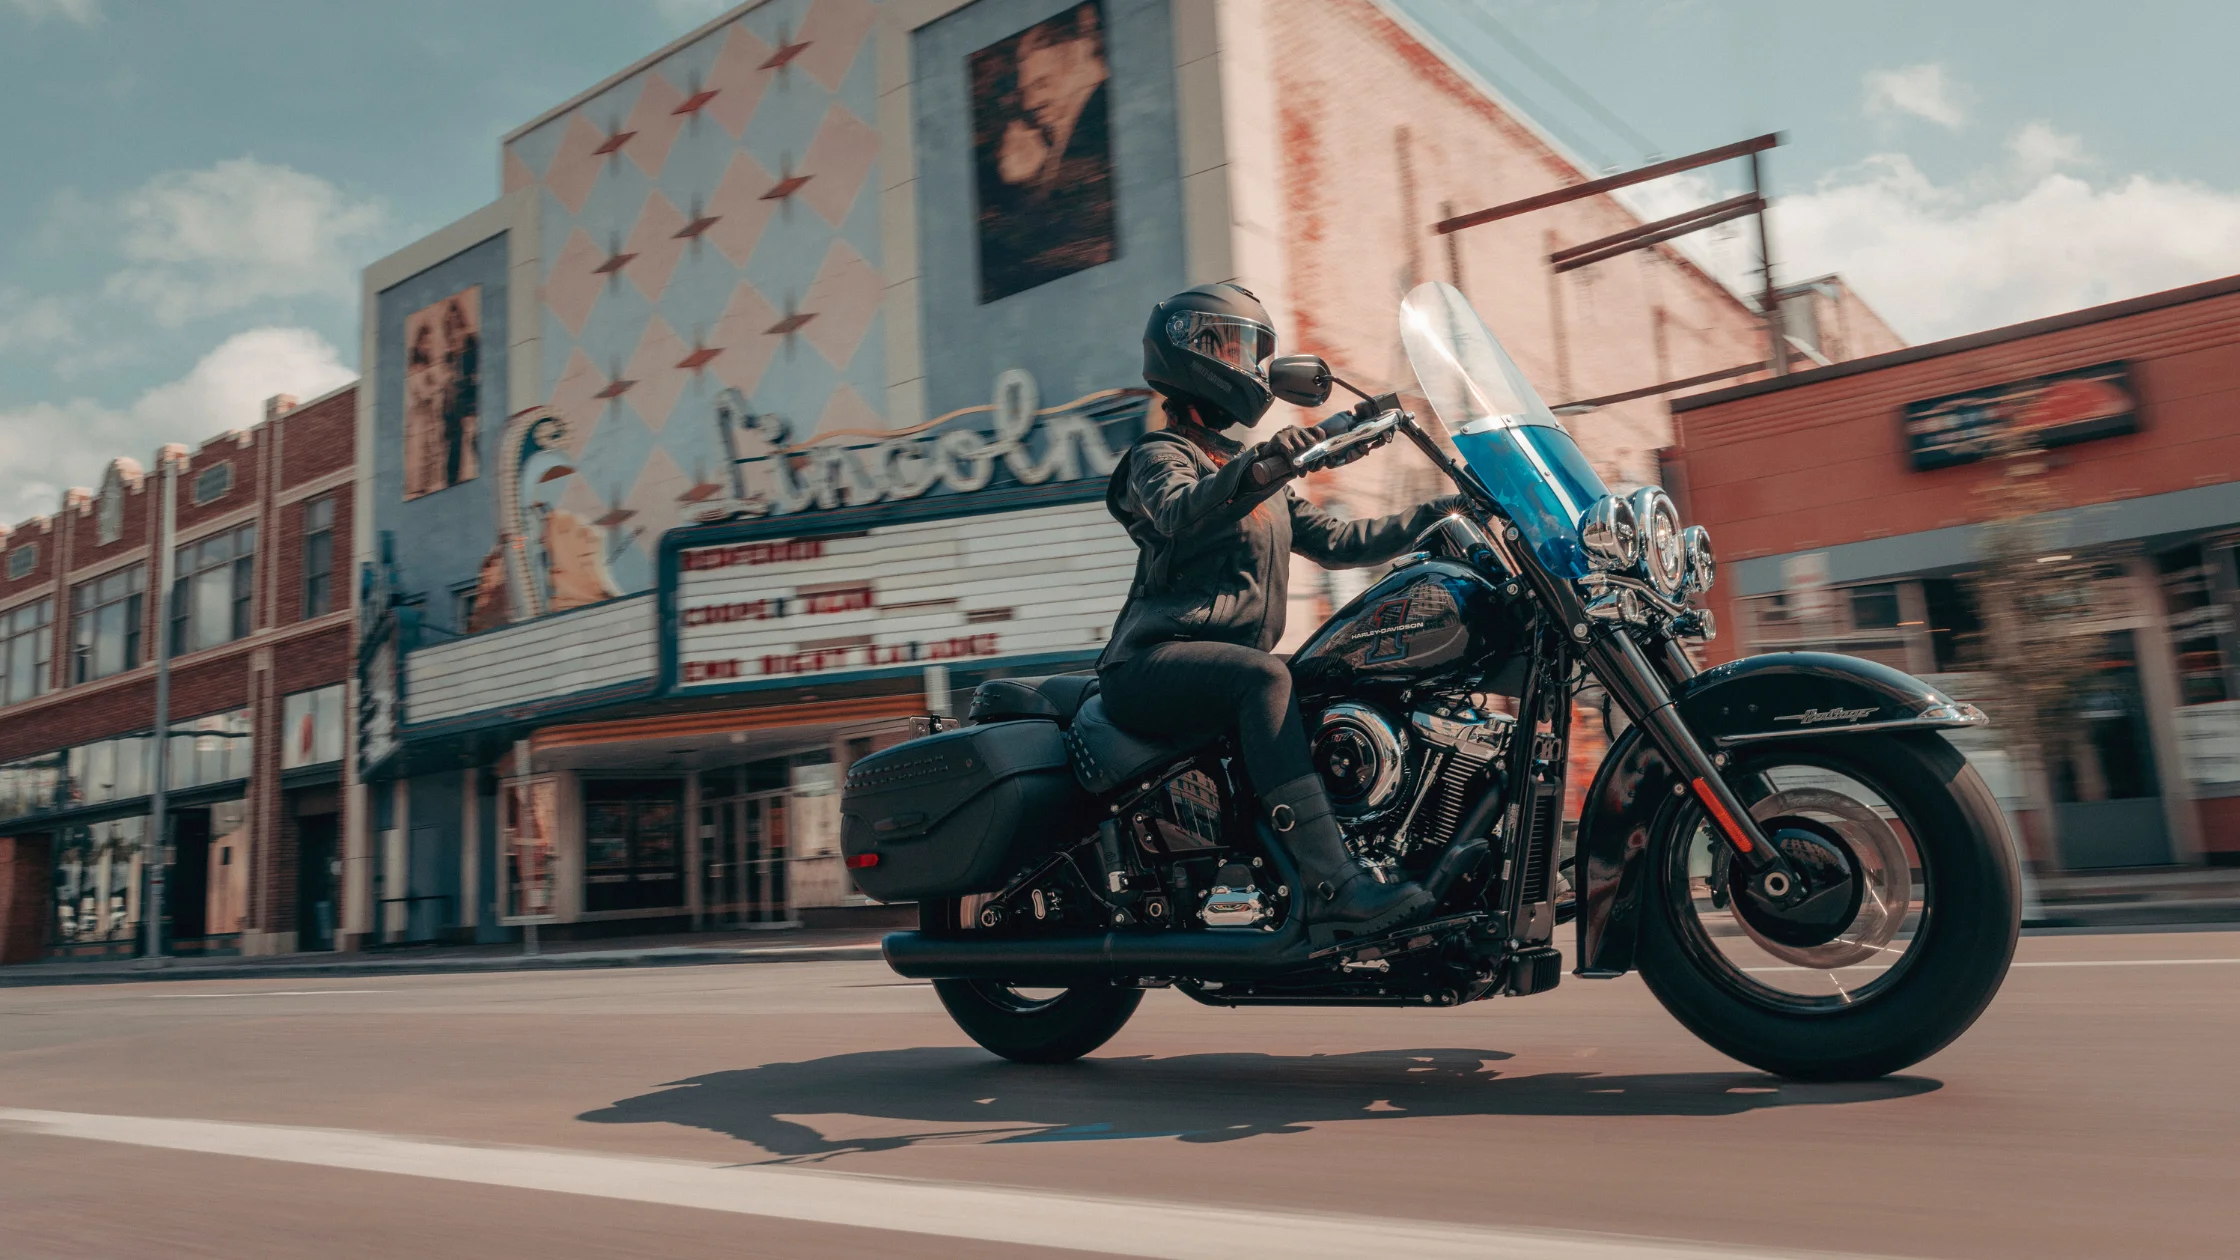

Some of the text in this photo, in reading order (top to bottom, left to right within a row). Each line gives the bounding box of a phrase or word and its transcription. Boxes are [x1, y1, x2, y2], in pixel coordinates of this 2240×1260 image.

[681, 368, 1130, 524] Lincoln
[1351, 622, 1424, 640] HARLEY-DAVIDSON
[760, 646, 848, 676] NIGHT
